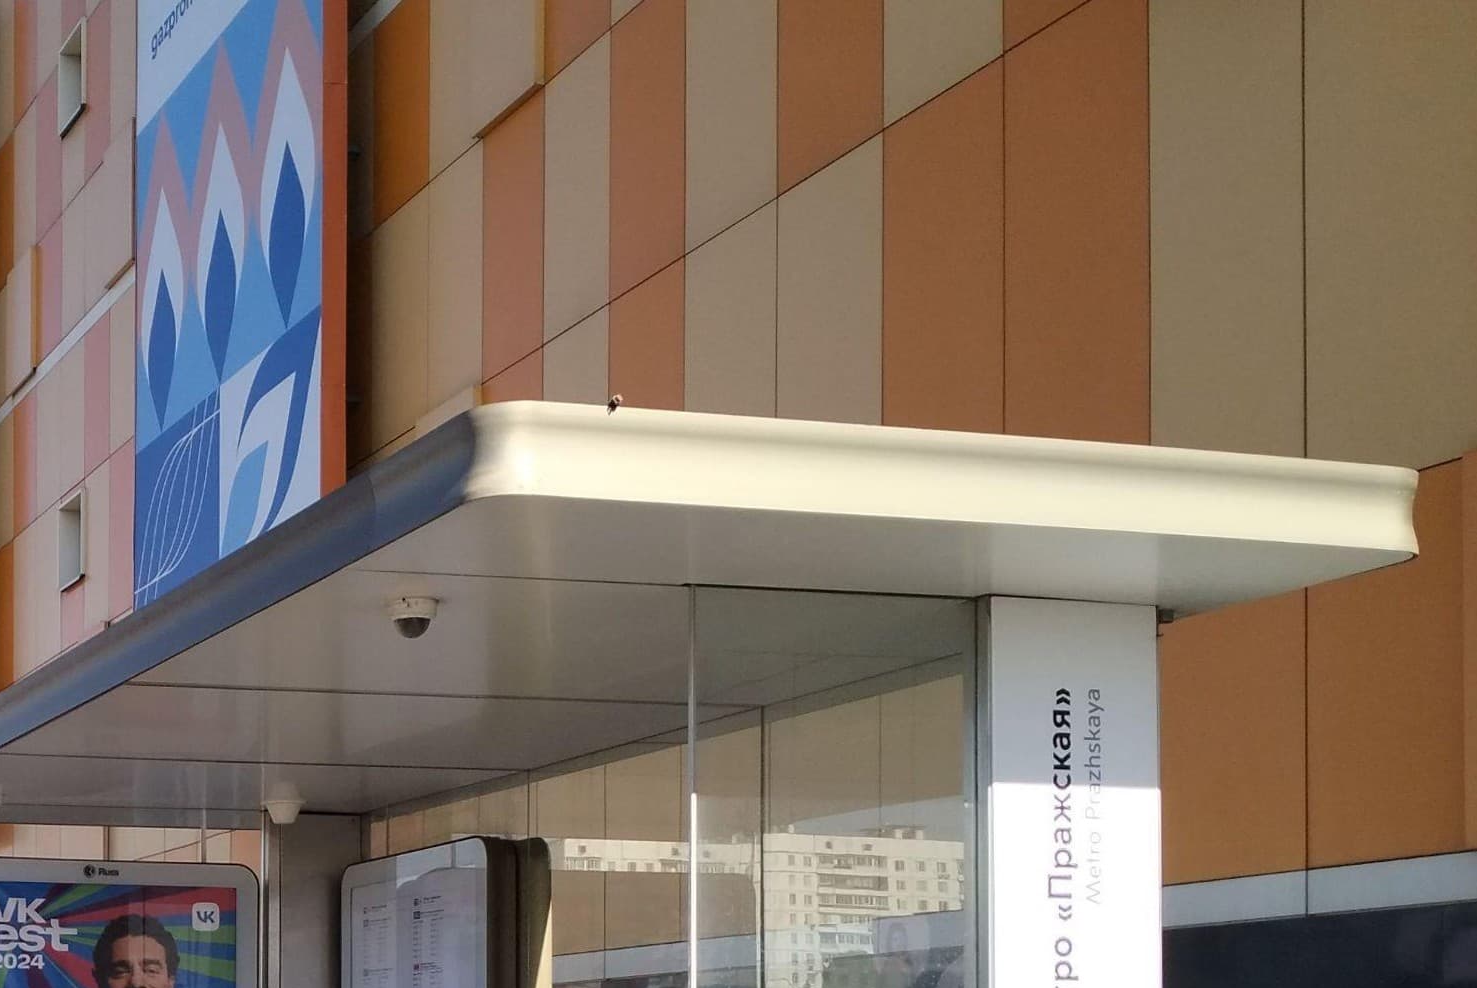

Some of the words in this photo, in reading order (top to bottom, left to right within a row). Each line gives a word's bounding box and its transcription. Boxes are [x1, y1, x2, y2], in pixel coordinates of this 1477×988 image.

[1048, 687, 1078, 921] «Пражская»
[1084, 688, 1105, 820] Prazhskaya
[1085, 831, 1102, 905] Metro
